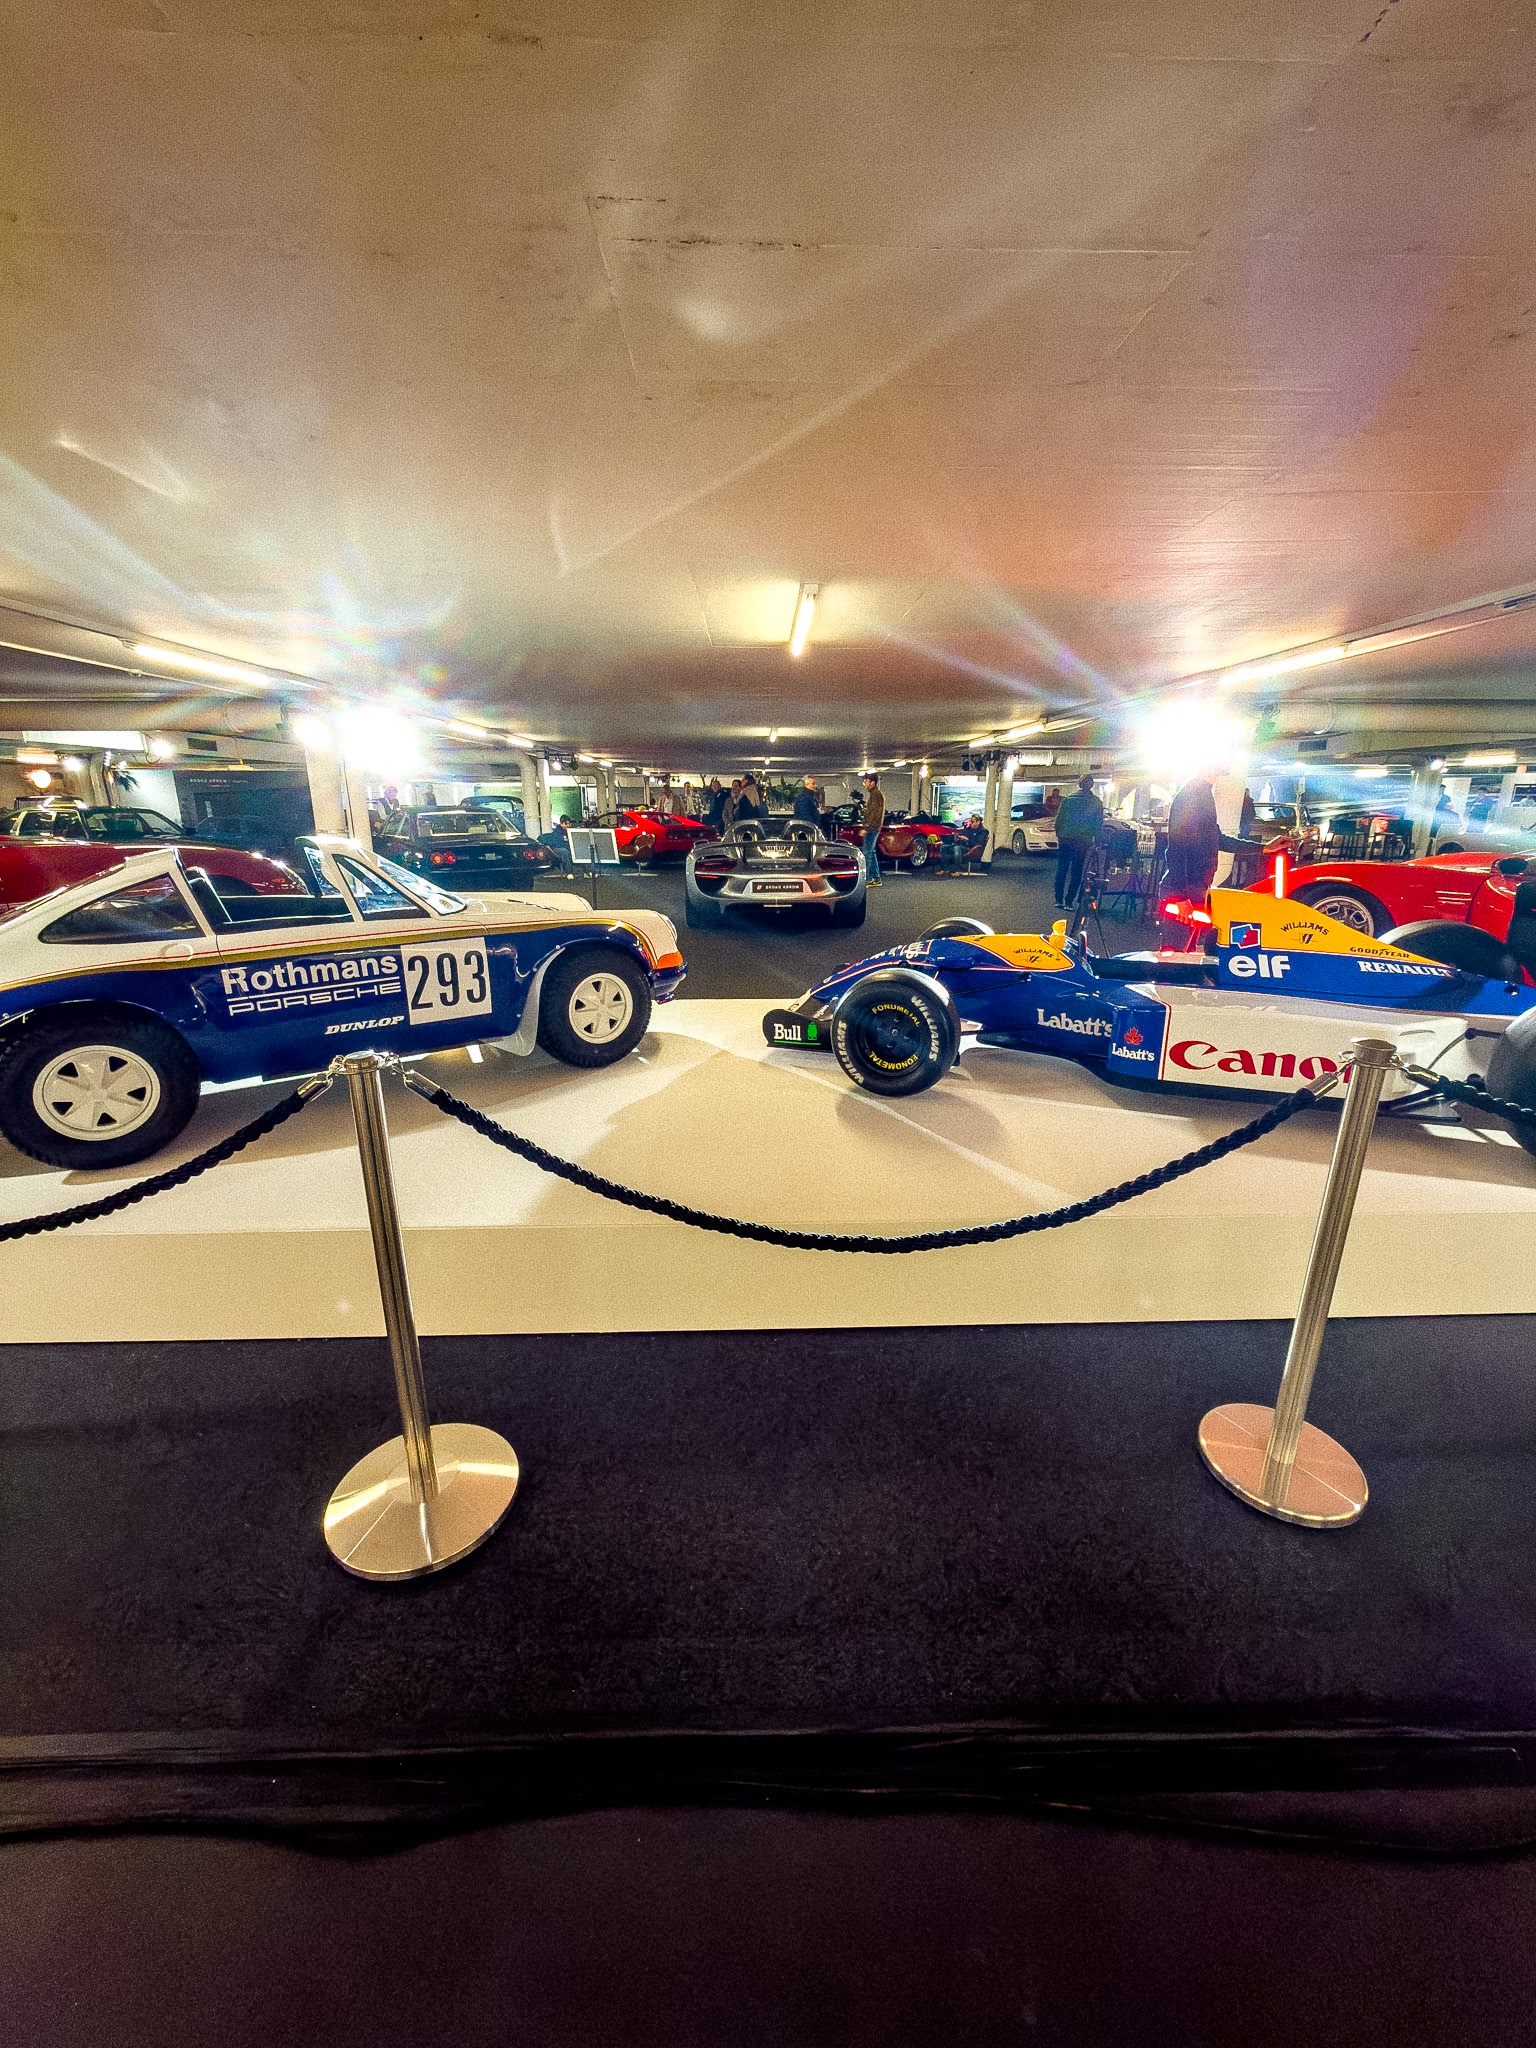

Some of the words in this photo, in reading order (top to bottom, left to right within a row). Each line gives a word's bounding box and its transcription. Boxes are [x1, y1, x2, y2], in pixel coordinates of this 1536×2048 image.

[1280, 921, 1330, 936] WILLIAMS
[1350, 946, 1411, 960] GOODYEAR
[221, 953, 400, 996] Rothmans
[1228, 953, 1292, 979] elf
[1357, 960, 1453, 978] RENAULT
[407, 949, 488, 1012] 293
[227, 981, 402, 1017] PORSCHE
[324, 1015, 405, 1036] DUNLOP
[773, 1022, 802, 1041] Bull
[910, 994, 940, 1062] WILLIAMS
[1036, 1007, 1114, 1039] Labatt's
[837, 1019, 865, 1085] WILLIAMS
[868, 1050, 919, 1071] FONDMETAL
[1111, 1042, 1156, 1063] Labatt's
